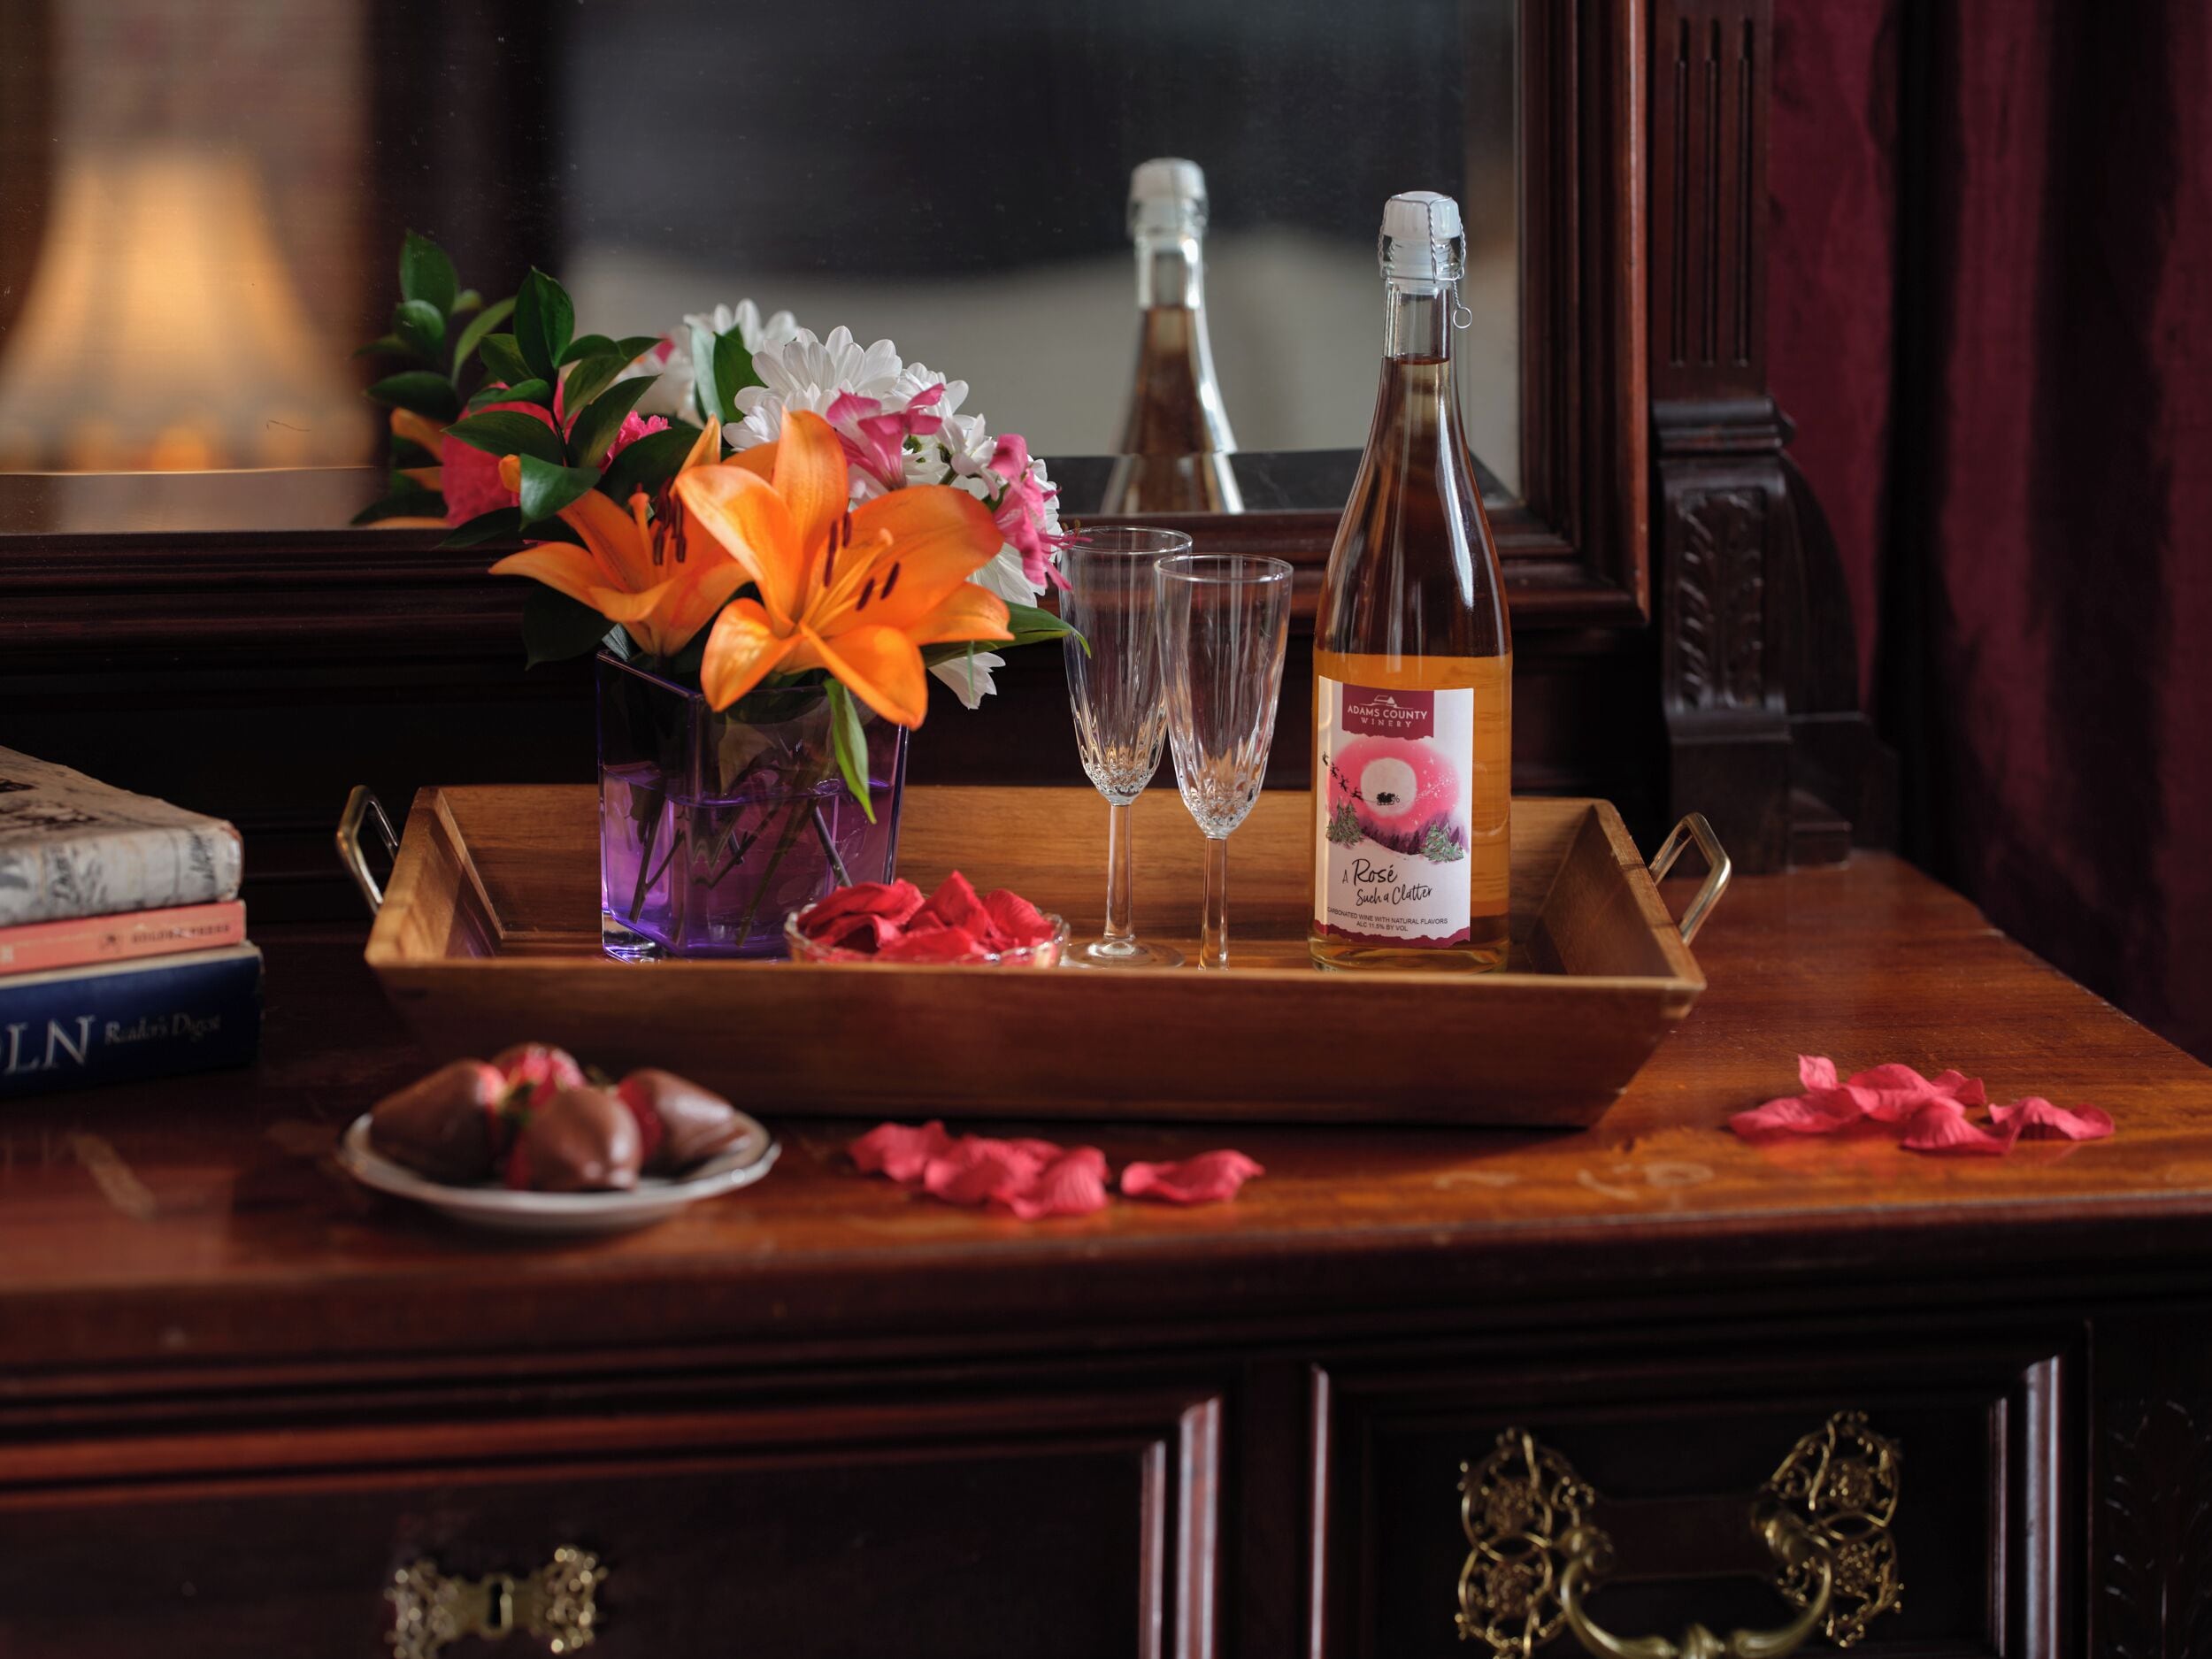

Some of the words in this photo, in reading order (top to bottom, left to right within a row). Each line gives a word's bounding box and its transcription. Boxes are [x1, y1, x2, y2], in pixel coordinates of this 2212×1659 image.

[1348, 705, 1379, 717] ADAMS
[1383, 710, 1427, 719] COUNTY
[1361, 717, 1411, 727] WINERY
[1342, 869, 1348, 884] A
[1352, 858, 1398, 886] Rosé
[1356, 887, 1382, 906] Such
[1384, 893, 1389, 902] a
[1392, 883, 1432, 905] Clatter
[0, 1014, 96, 1076] LN
